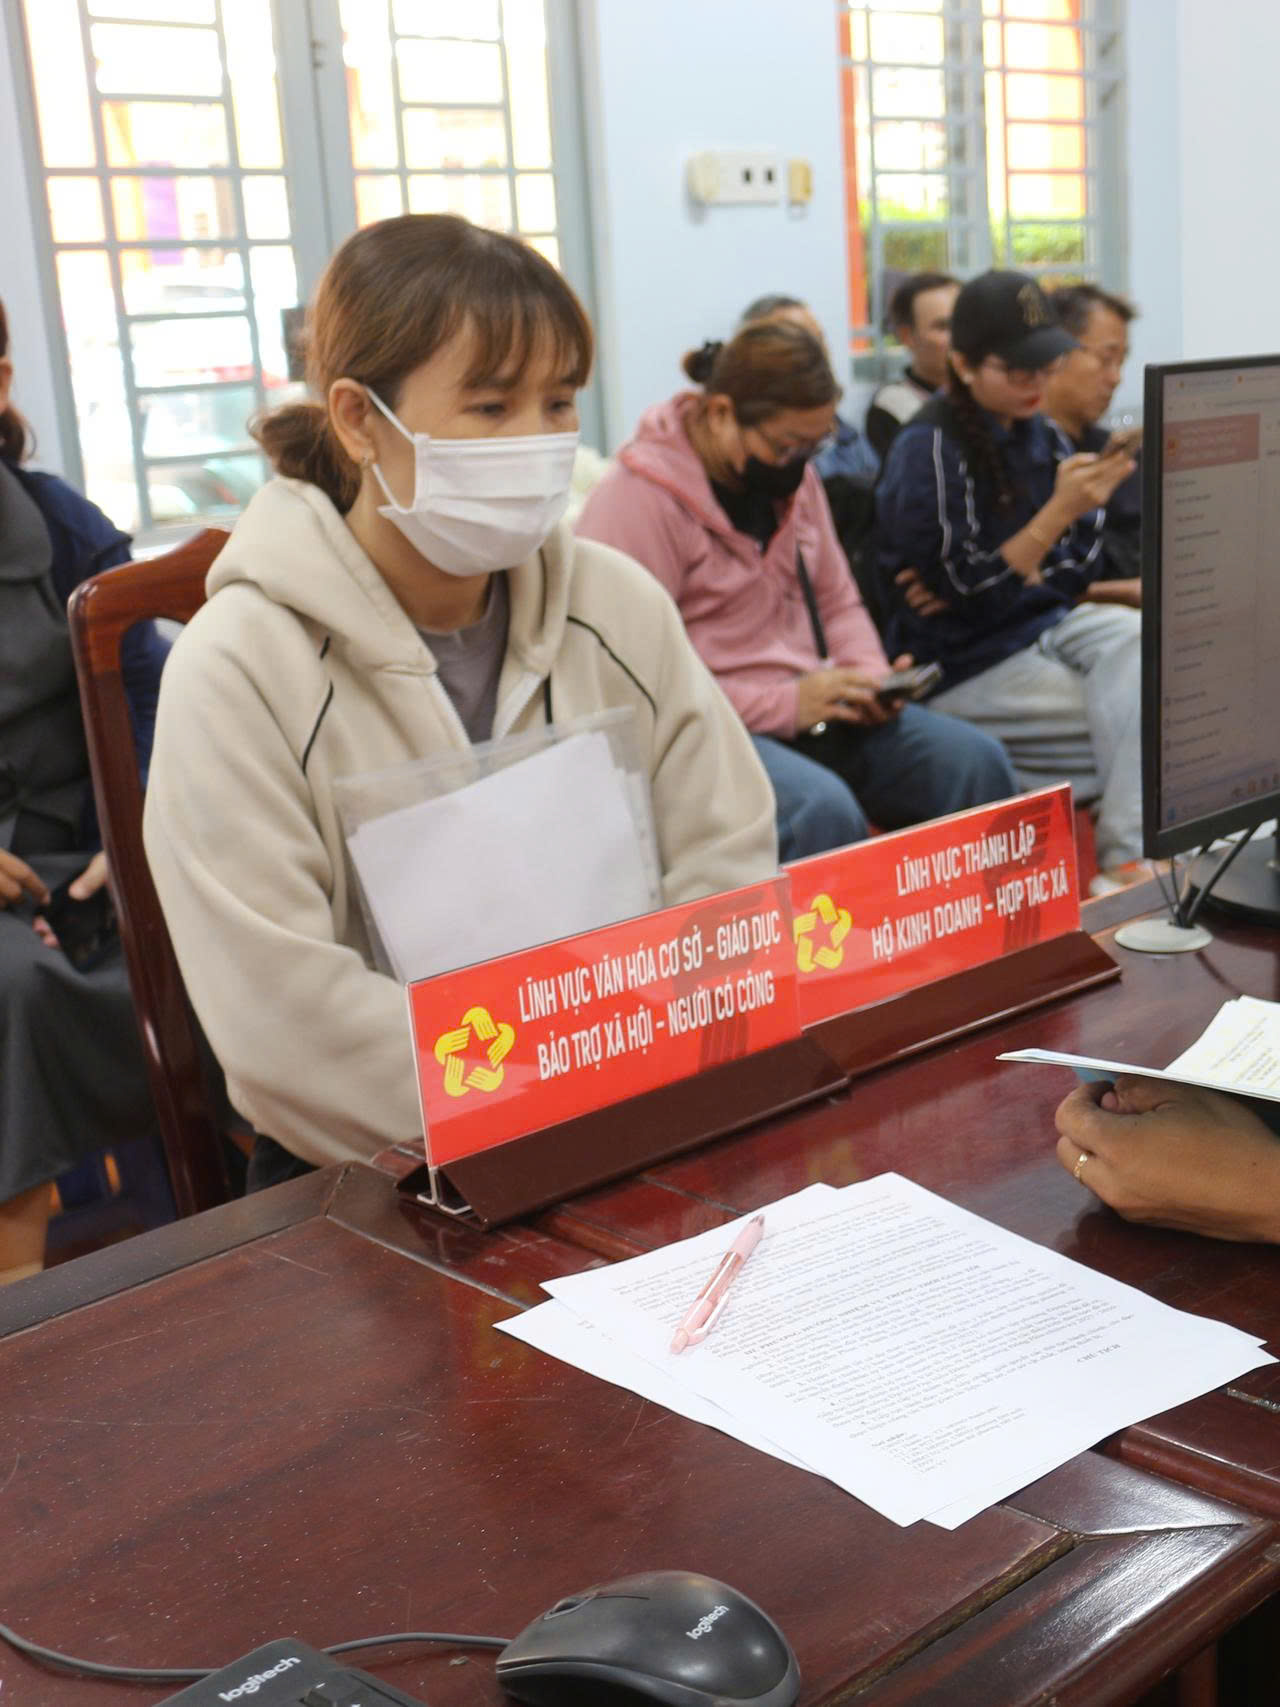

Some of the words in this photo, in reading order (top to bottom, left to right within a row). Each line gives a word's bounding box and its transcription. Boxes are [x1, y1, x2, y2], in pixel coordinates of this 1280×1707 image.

[895, 855, 931, 896] LĨNH
[931, 846, 962, 889] VỰC
[962, 832, 1008, 875] THÀNH
[1010, 820, 1036, 865] LẬP
[871, 916, 894, 963] HỘ
[895, 909, 932, 951] KINH
[933, 893, 983, 939] DOANH
[996, 878, 1025, 921] HỢP
[1024, 868, 1049, 908] TÁC
[1050, 859, 1069, 900] XÃ
[518, 977, 557, 1024] LĨNH
[558, 966, 592, 1015] VỰC
[592, 955, 625, 1000] VĂN
[626, 942, 657, 991] HÓA
[659, 939, 679, 979] CƠ
[682, 925, 702, 972] SỞ
[716, 915, 749, 961] GIÁO
[751, 910, 781, 955] DỤC
[537, 1030, 570, 1081] BẢO
[571, 1023, 602, 1070] TRỢ
[603, 1013, 626, 1059] XÃ
[626, 1004, 654, 1055] HỘI
[667, 985, 713, 1038] NGƯỜI
[714, 977, 734, 1021] CÓ
[736, 970, 775, 1014] CÔNG
[685, 1605, 730, 1640] logitech
[218, 1656, 301, 1702] logitech
